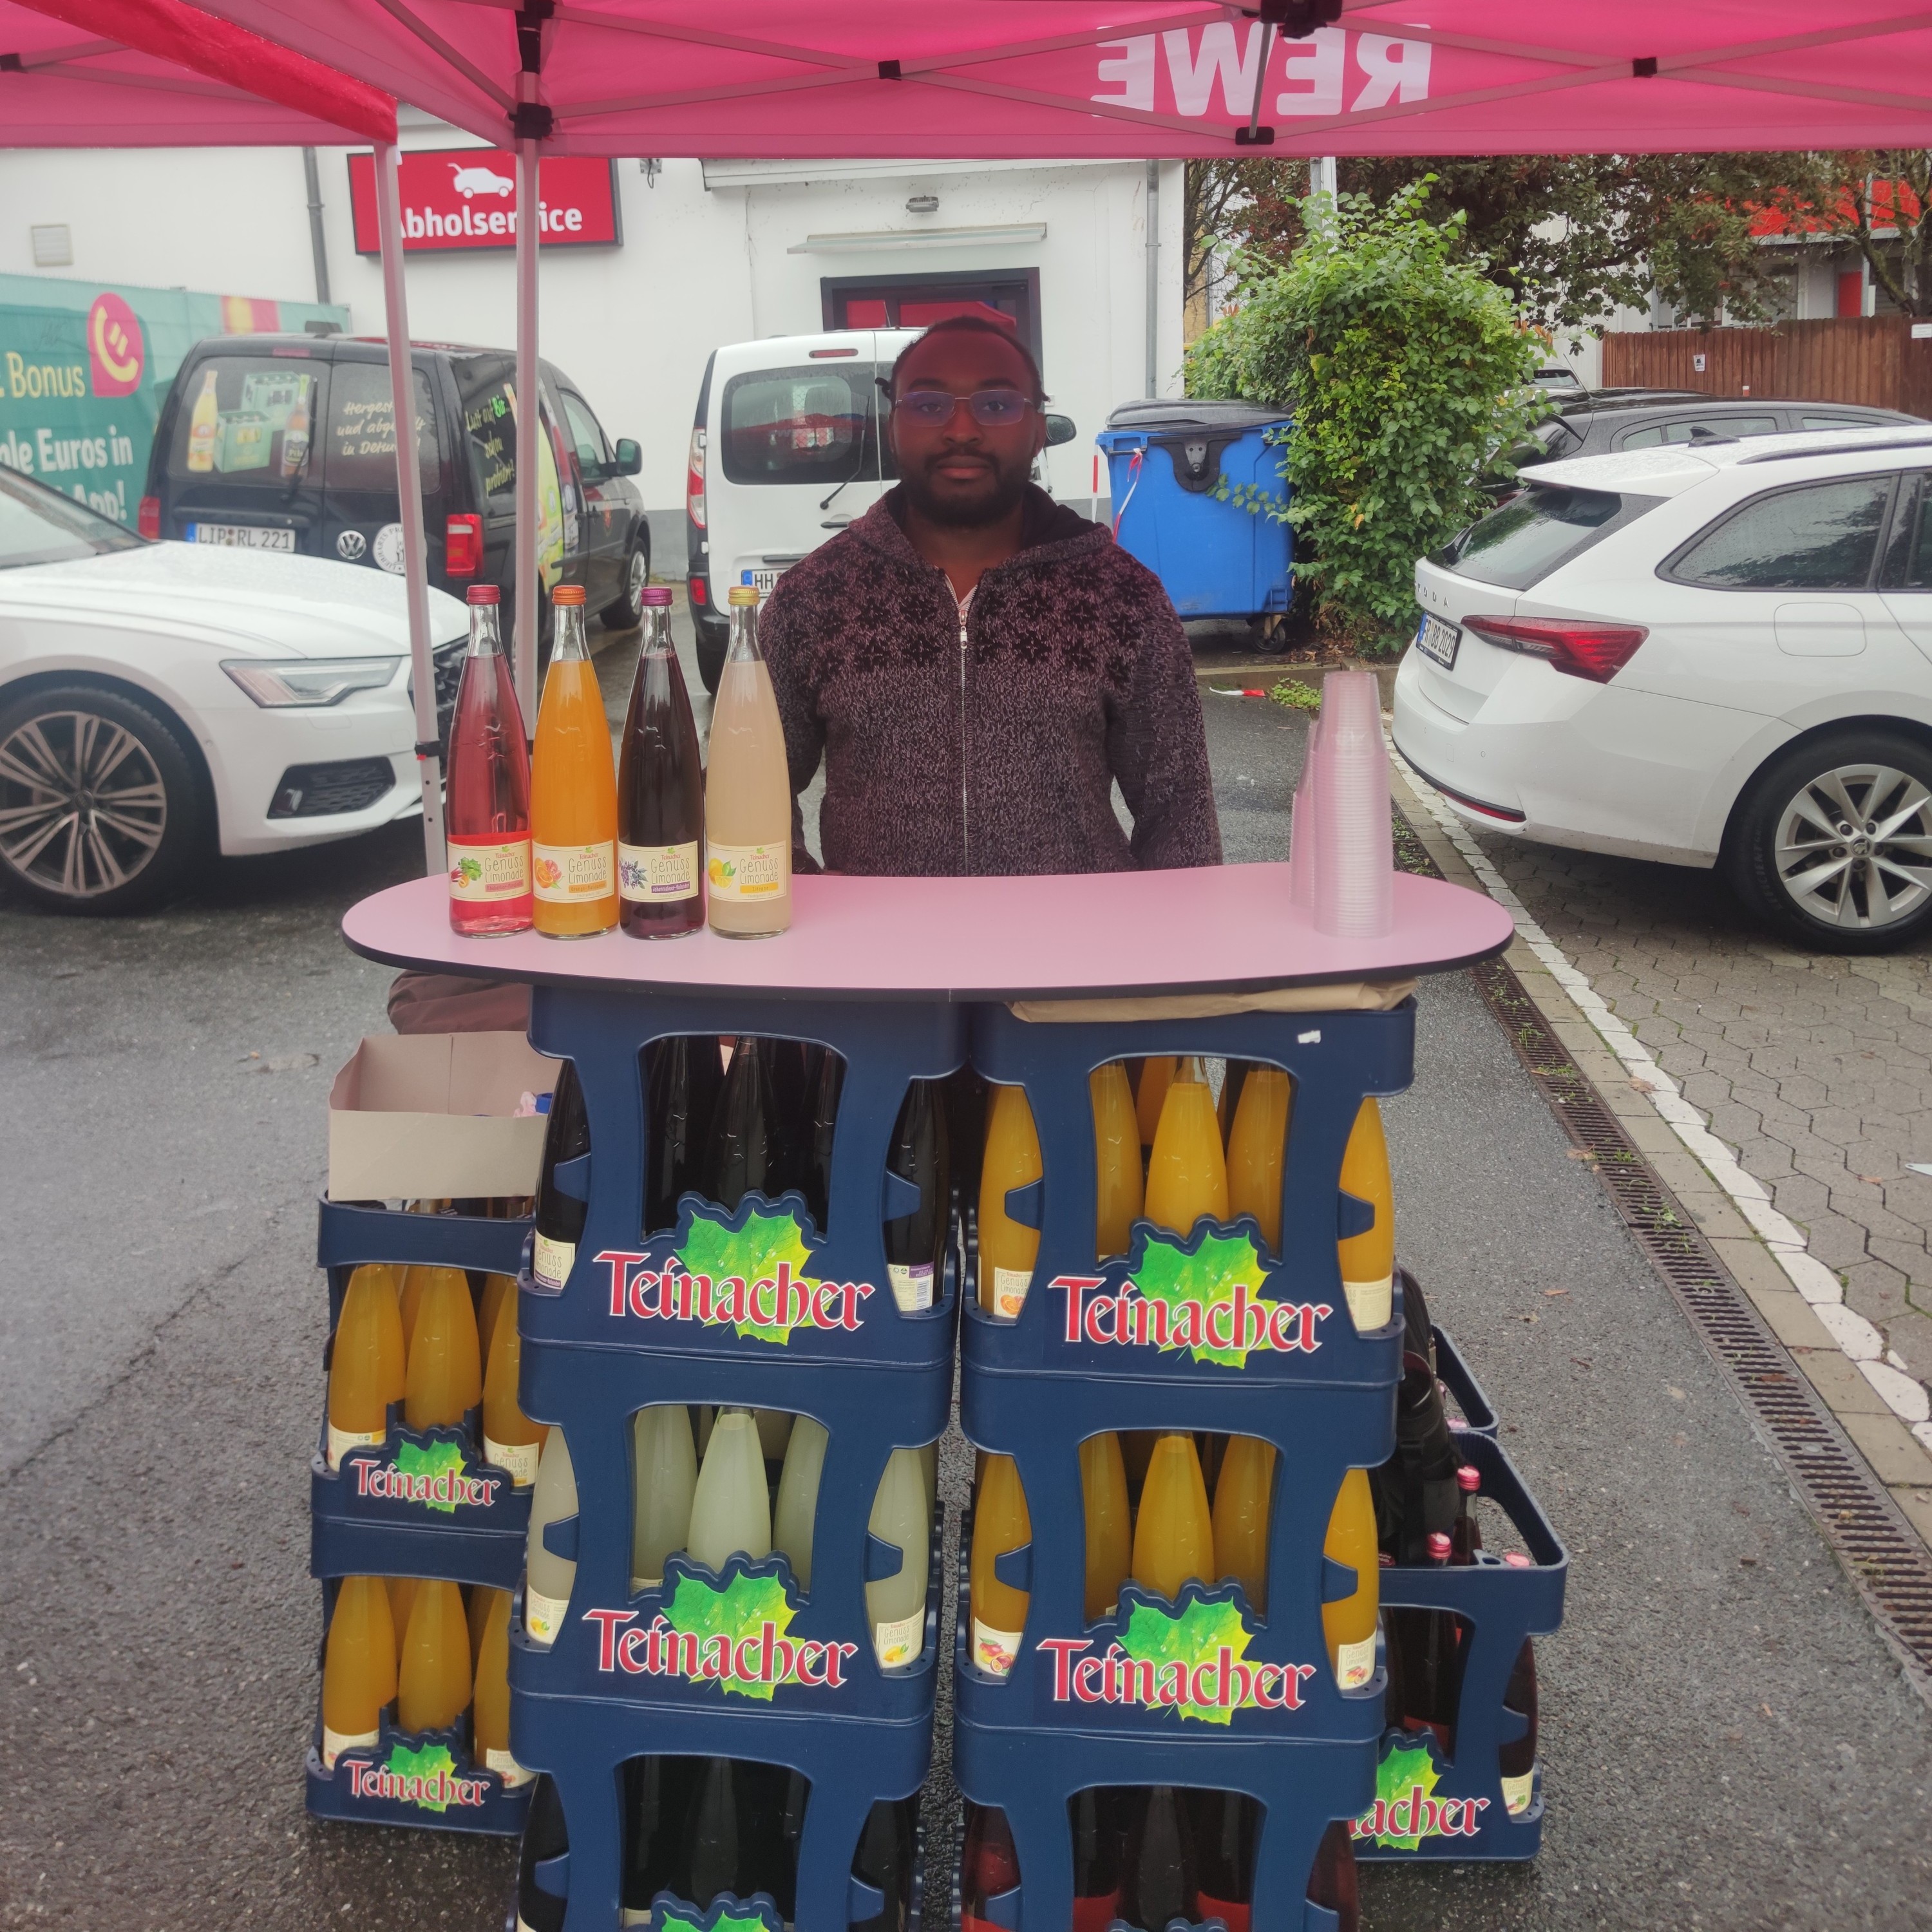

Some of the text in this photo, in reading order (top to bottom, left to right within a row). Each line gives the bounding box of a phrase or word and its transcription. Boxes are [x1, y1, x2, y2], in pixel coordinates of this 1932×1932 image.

[401, 202, 582, 238] bholserice
[6, 352, 86, 399] Bonus
[337, 419, 365, 437] und
[37, 427, 108, 473] Euros
[108, 424, 134, 466] in
[342, 441, 355, 456] in
[198, 529, 290, 549] LIP RL 221
[755, 573, 773, 589] HH
[1430, 623, 1441, 649] BB
[1438, 629, 1455, 659] 2029
[485, 855, 524, 871] Genuss
[569, 857, 607, 873] Genuss
[651, 857, 690, 873] Genuss
[740, 858, 778, 873] Genuss
[485, 868, 524, 882] Limonade
[569, 869, 607, 884] Limonade
[651, 869, 690, 884] Limonade
[740, 870, 778, 884] Limonade
[1001, 1274, 1028, 1287] Genuss
[592, 1251, 875, 1332] Teinacher
[1048, 1276, 1334, 1354] Teinacher
[349, 1458, 501, 1507] Teinacher
[884, 1625, 909, 1638] Genuss
[582, 1609, 858, 1688] Teinacher
[1036, 1638, 1317, 1710] Teinacher
[343, 1759, 491, 1807] Teinacher
[1349, 1785, 1491, 1837] acher
